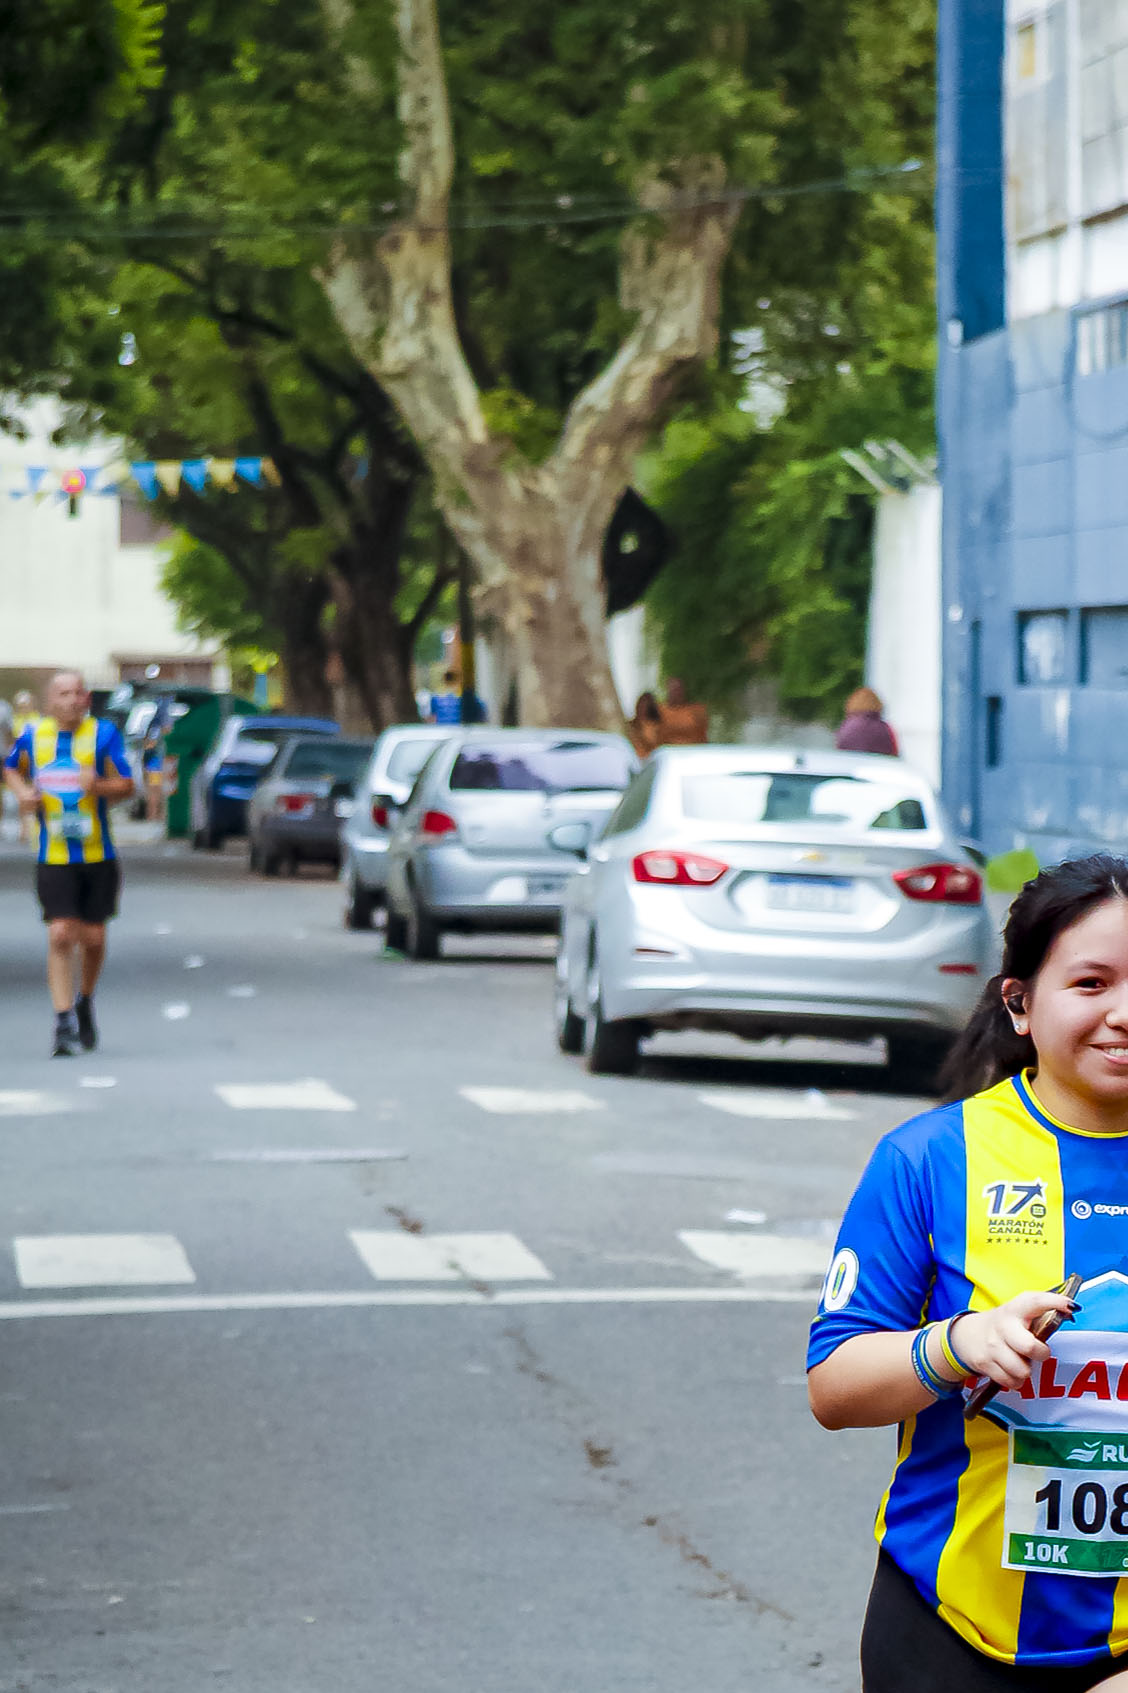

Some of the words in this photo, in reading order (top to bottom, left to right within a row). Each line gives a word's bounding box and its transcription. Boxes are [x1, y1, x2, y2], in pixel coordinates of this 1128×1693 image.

[985, 1182, 1045, 1216] 17
[988, 1219, 1044, 1229] MARATÓN
[988, 1226, 1044, 1236] CANALLA
[1023, 1541, 1070, 1564] 10K
